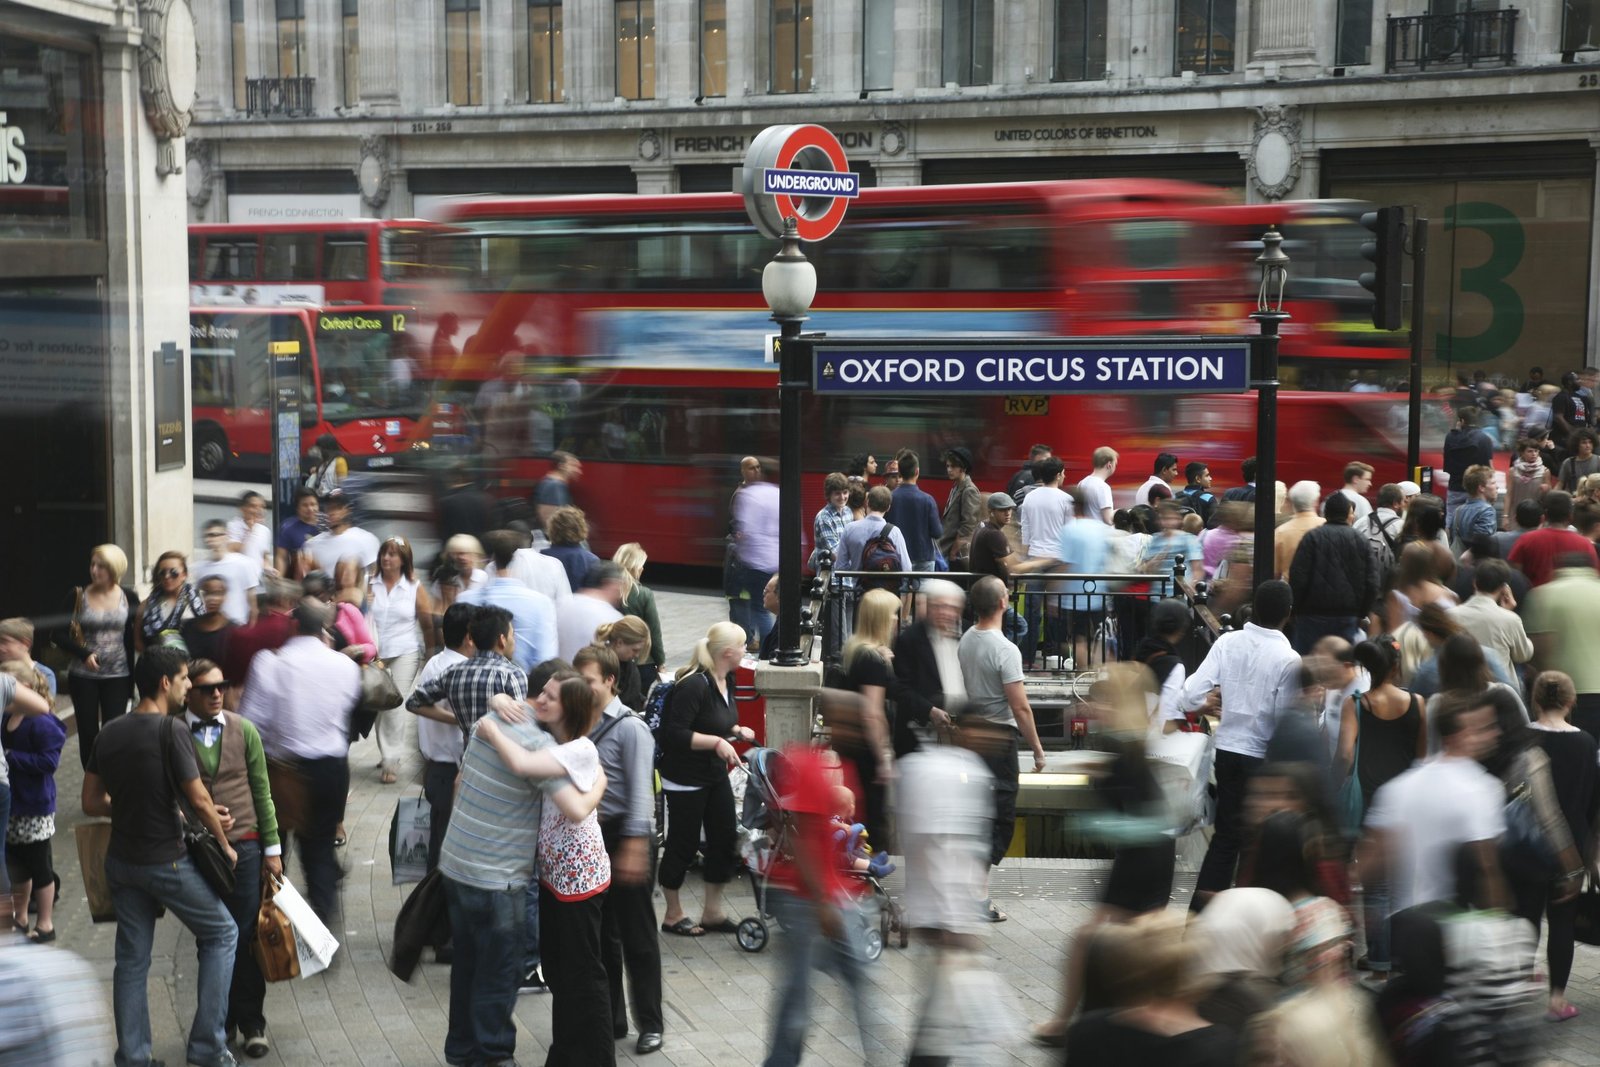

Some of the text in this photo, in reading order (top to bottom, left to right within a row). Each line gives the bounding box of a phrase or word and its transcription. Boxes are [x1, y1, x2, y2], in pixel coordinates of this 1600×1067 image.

[994, 130, 1032, 141] UNITED
[1033, 128, 1077, 140] COLORS
[1078, 127, 1095, 139] OF
[674, 135, 745, 152] FRENCH
[767, 174, 855, 192] UNDERGROUND
[247, 207, 344, 218] FRENCH CONNECTION
[1435, 201, 1525, 363] 3
[320, 316, 353, 330] Oxford
[392, 313, 406, 332] 12
[208, 324, 240, 339] Arrow
[839, 356, 1224, 383] OXFORD CIRCUS STATION
[1008, 399, 1046, 412] RVP
